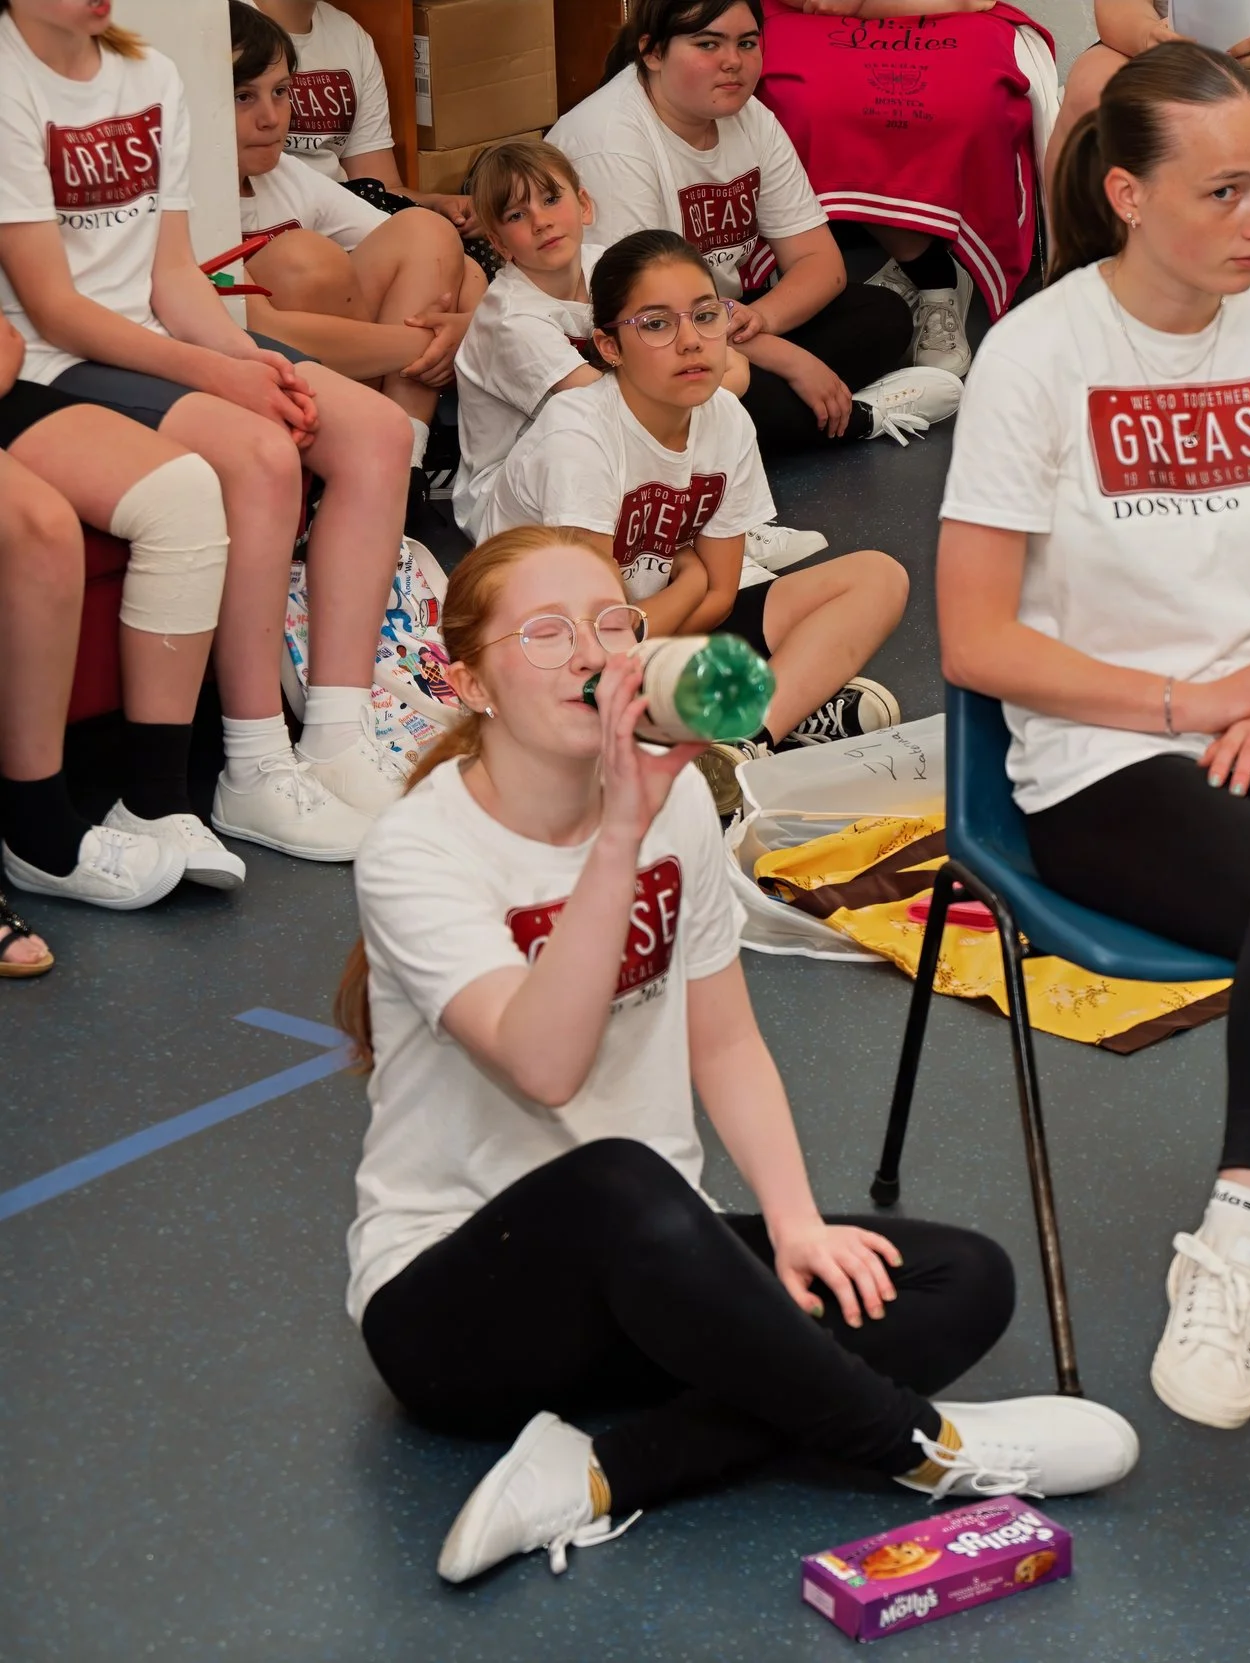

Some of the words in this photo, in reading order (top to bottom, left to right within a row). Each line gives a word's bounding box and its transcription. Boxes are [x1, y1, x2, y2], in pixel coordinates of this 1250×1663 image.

[827, 27, 957, 51] Ladies
[1130, 395, 1152, 412] WE
[1156, 393, 1178, 411] GO
[1148, 471, 1177, 486] THE
[655, 488, 669, 500] GO
[1113, 494, 1240, 521] DOSYTCo
